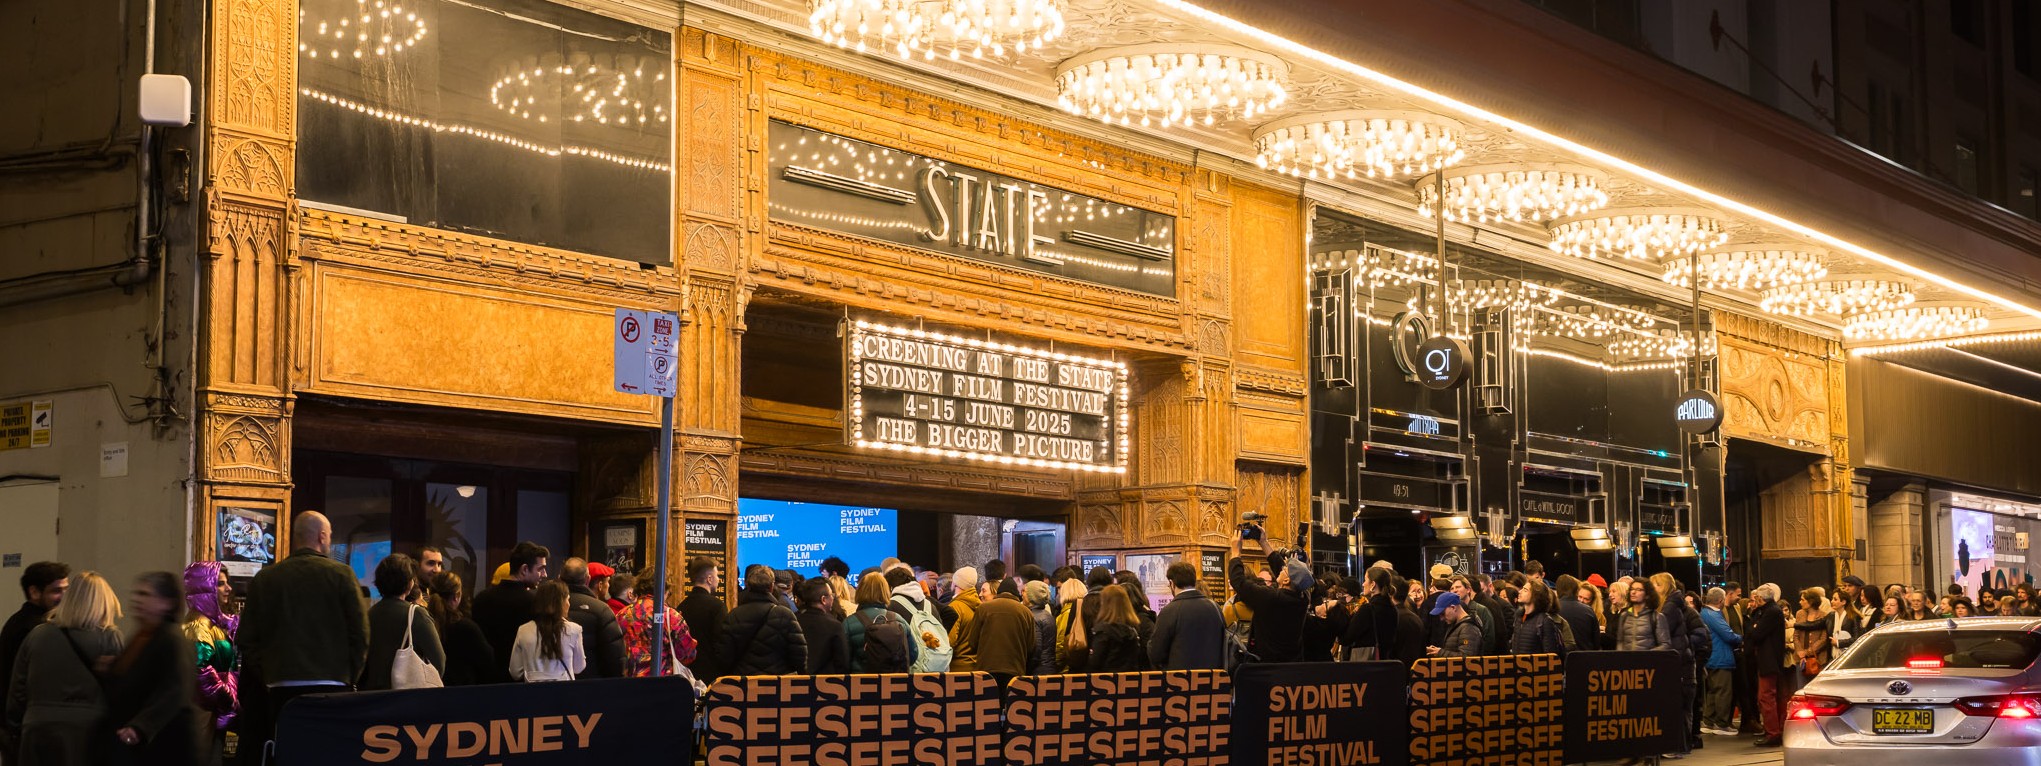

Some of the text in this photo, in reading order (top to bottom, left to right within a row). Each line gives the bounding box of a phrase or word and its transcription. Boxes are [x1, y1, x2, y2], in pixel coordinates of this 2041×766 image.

[918, 166, 1064, 265] STATE
[978, 352, 1000, 376] AT
[1013, 358, 1049, 382] THE
[1059, 364, 1114, 393] STATE
[1425, 348, 1451, 375] QT
[864, 362, 1104, 414] SYDNEY FILM FESTIVAL
[905, 394, 1071, 435] 4-15 JUNE 2025
[1677, 398, 1714, 420] PARLOUR
[8, 438, 20, 447] 24/7
[877, 418, 1093, 461] THE BIGGER PICTURE
[737, 514, 774, 524] SYDNEY
[841, 508, 880, 518] SYDNEY
[841, 517, 864, 526] FILM
[685, 523, 717, 531] SYDNEY
[737, 523, 758, 531] FILM
[737, 530, 779, 539] FESTIVAL
[841, 525, 886, 534] FESTIVAL
[685, 537, 721, 545] FESTIVAL
[787, 543, 826, 552] SYDNEY
[787, 552, 810, 560] FILM
[787, 560, 823, 568] FESTIV
[1411, 673, 1563, 706] SFF SFF SFF
[1587, 669, 1655, 692] SYDNEY
[1269, 683, 1367, 712] SYDNEY
[1587, 694, 1627, 716] FILM
[708, 699, 1000, 740] SFF SFF SFF
[1007, 693, 1232, 732] SFF SFF SFF
[1410, 698, 1563, 734] SFF SFF SFF
[1875, 711, 1931, 725] DC 22 MB
[360, 713, 603, 763] SYDNEY
[1268, 714, 1327, 742] FILM
[1587, 716, 1662, 742] FESTIVAL
[1004, 724, 1230, 766] SFF SFF SFF
[1268, 740, 1380, 766] FESTIVAL
[1409, 732, 1464, 762] SFF
[1465, 728, 1515, 754] SFF
[1517, 724, 1563, 749] SFF
